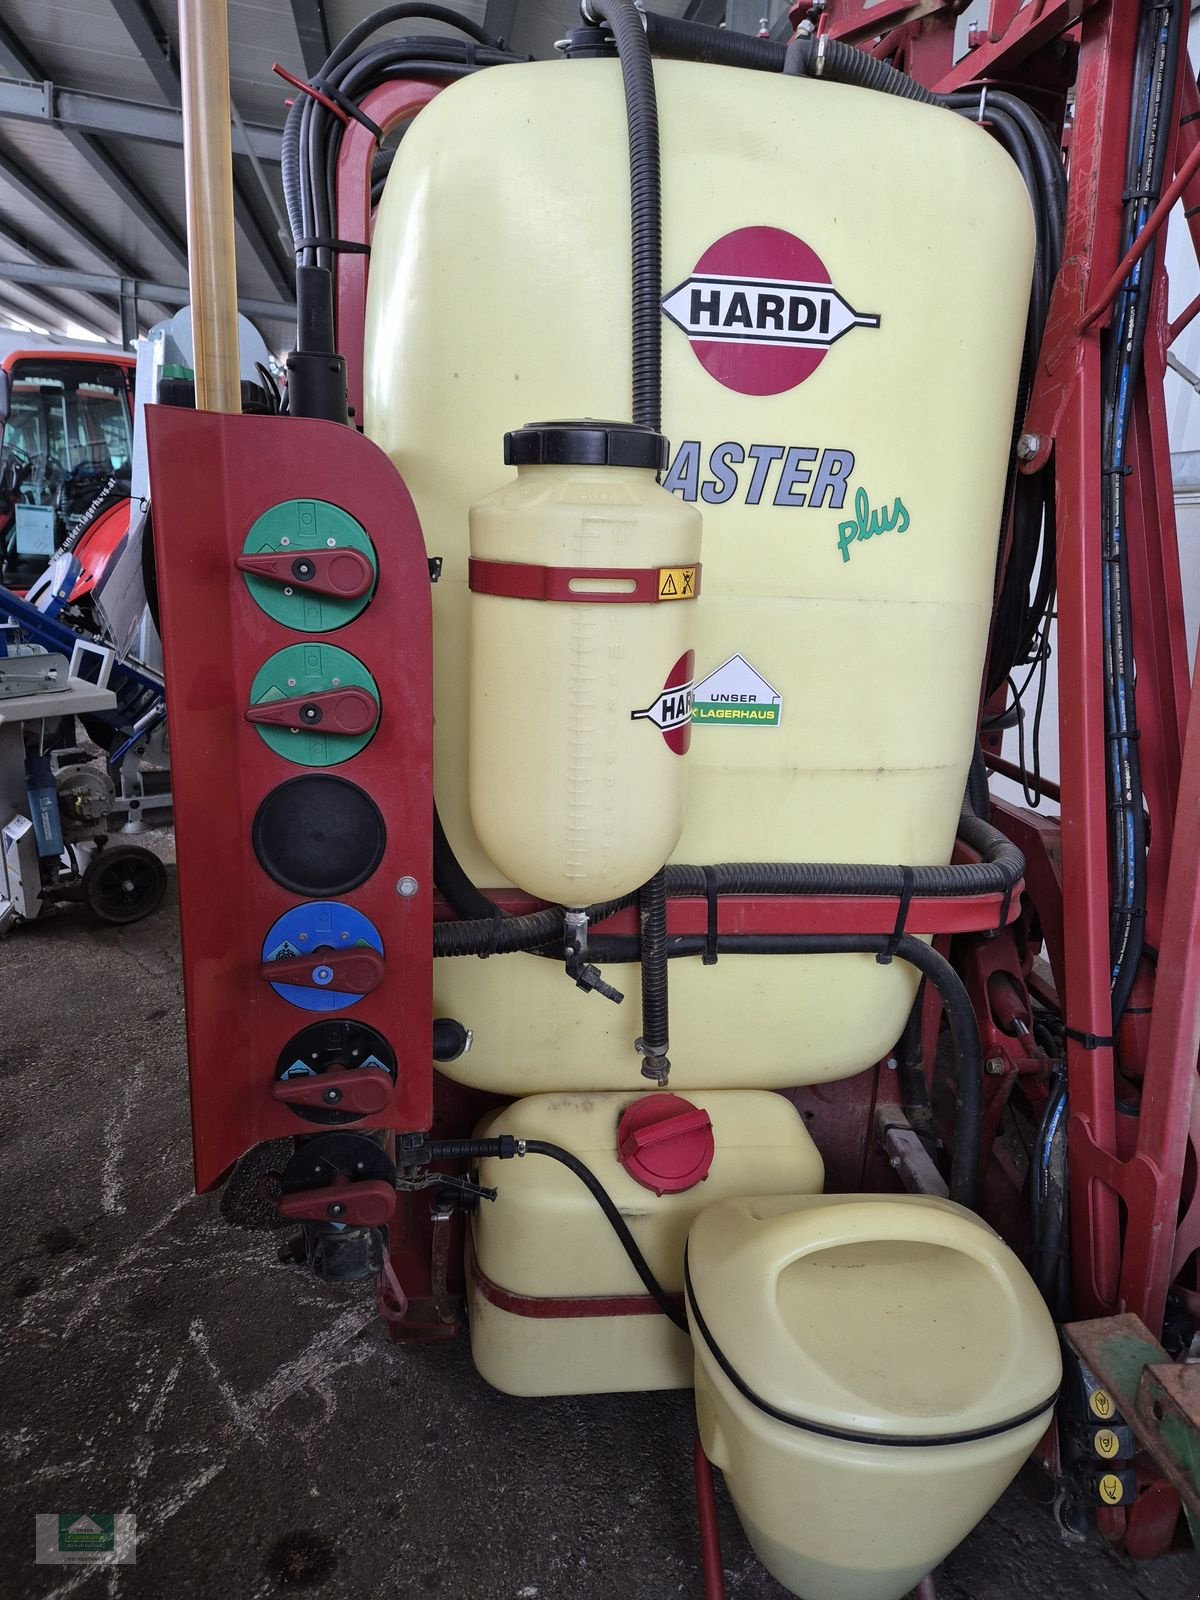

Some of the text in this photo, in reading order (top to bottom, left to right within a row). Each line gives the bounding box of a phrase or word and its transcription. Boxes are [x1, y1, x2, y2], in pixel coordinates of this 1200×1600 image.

[689, 288, 831, 335] HARDI
[662, 440, 856, 510] ASTER
[837, 486, 911, 564] plus
[661, 690, 693, 723] HAR
[700, 707, 775, 719] LAGERHAUS
[710, 693, 757, 703] UNSER
